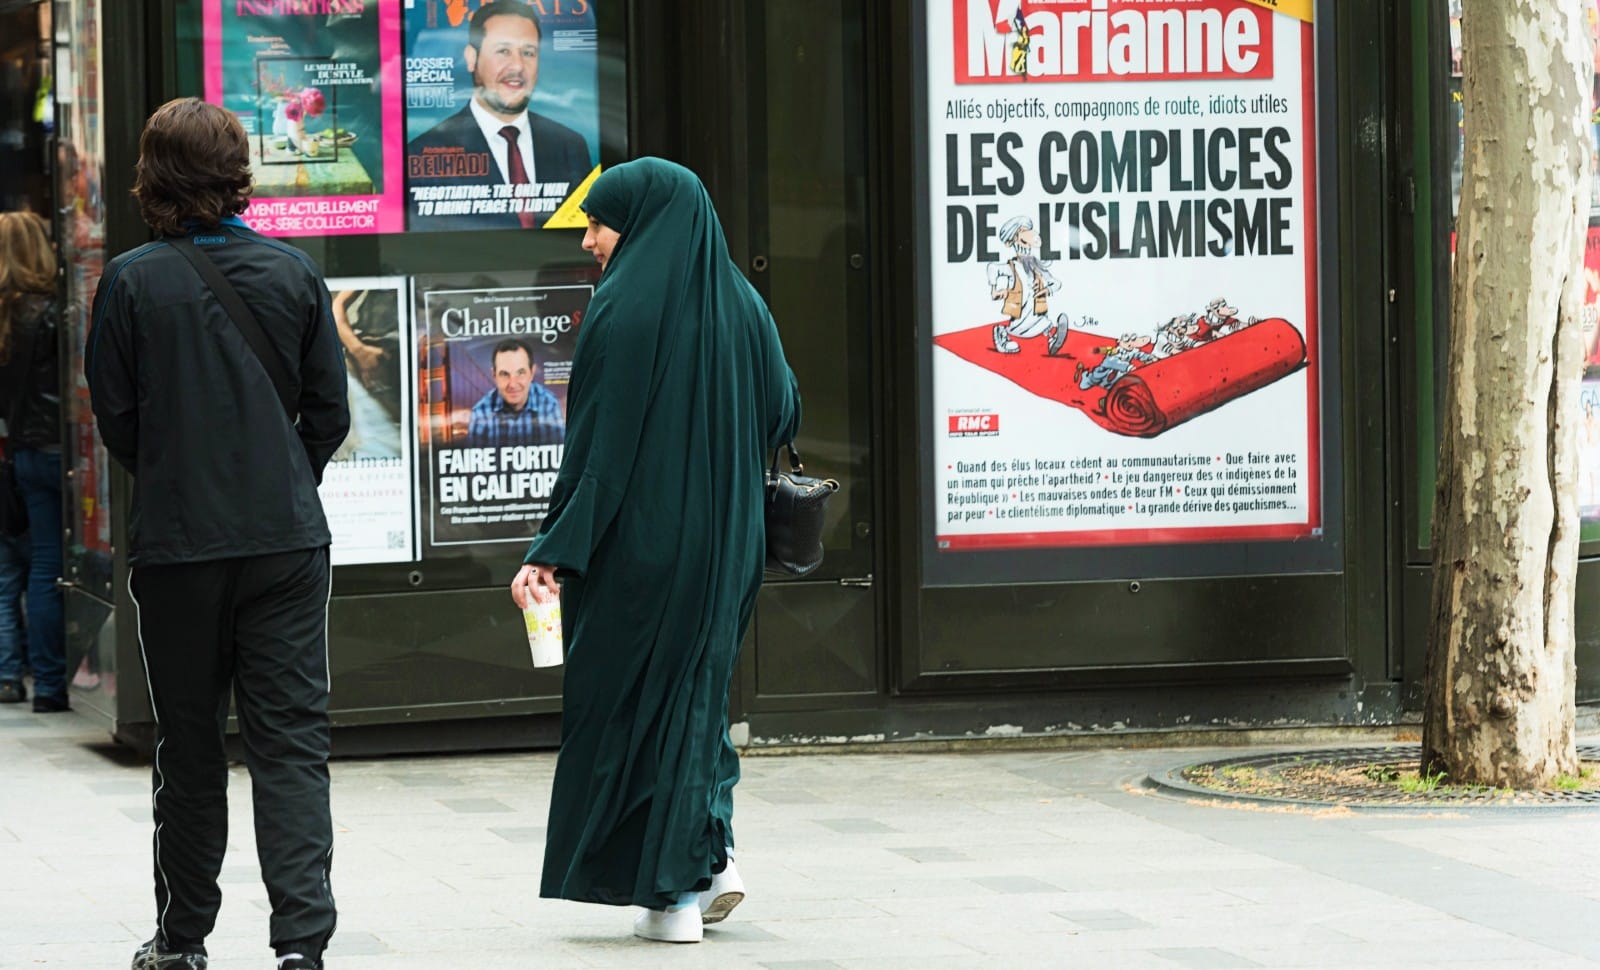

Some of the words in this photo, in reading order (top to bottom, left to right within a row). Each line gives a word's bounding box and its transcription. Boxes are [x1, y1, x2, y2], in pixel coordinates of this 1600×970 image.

[967, 0, 1260, 77] Marianne
[332, 69, 364, 79] STYLE
[406, 57, 454, 70] DOSSIER
[406, 86, 455, 108] LIBYE
[946, 100, 983, 120] Alliés
[987, 97, 1049, 123] objectifs,
[1054, 99, 1141, 124] compagnons
[1144, 96, 1160, 116] de
[1164, 96, 1204, 118] route,
[1209, 94, 1247, 115] idiots
[1251, 93, 1288, 114] utiles
[408, 152, 489, 178] BELHADJ
[946, 131, 1025, 196] LES
[1038, 127, 1293, 195] COMPLICES
[493, 184, 515, 198] THE
[514, 183, 544, 197] ONLY
[543, 182, 570, 197] WAY
[250, 202, 287, 216] VENTE
[288, 199, 380, 215] ACTUELLEMENT
[418, 201, 434, 216] TO
[434, 199, 472, 215] BRING
[472, 197, 508, 214] PEACE
[508, 198, 524, 213] TO
[303, 215, 375, 230] COLLECTOR
[946, 203, 1000, 263] DE
[1039, 197, 1294, 260] L'ISLAMISME
[441, 306, 581, 343] Challenges
[957, 415, 991, 430] RMC
[328, 451, 402, 469] Salman
[439, 447, 497, 474] FAIRE
[957, 461, 986, 473] Quand
[991, 460, 1007, 472] des
[1011, 458, 1030, 471] élus
[1035, 458, 1066, 470] locaux
[1070, 456, 1102, 469] cèdent
[1106, 458, 1118, 469] au
[1122, 453, 1211, 467] communautarisme
[1226, 452, 1244, 465] Que
[1248, 451, 1270, 464] faire
[1275, 453, 1296, 463] avec
[440, 476, 468, 502] EN
[947, 479, 959, 489] un
[962, 478, 987, 488] imam
[990, 477, 1004, 490] qui
[1008, 474, 1039, 491] prêche
[1042, 473, 1093, 487] l'apartheid
[1112, 472, 1123, 483] Le
[1125, 472, 1140, 485] jeu
[1143, 471, 1193, 484] dangereux
[1196, 469, 1213, 481] des
[1226, 467, 1271, 482] indigènes
[1275, 467, 1285, 479] de
[1288, 467, 1297, 478] la
[947, 491, 999, 506] République
[1020, 490, 1035, 502] Les
[1038, 488, 1088, 501] mauvaises
[1090, 487, 1117, 499] ondes
[1121, 486, 1132, 498] de
[1135, 486, 1156, 498] Beur
[1160, 486, 1173, 498] FM
[1185, 485, 1207, 497] Ceux
[1211, 484, 1225, 498] qui
[1228, 482, 1297, 496] démissionnent
[947, 510, 962, 523] par
[965, 509, 986, 522] peur
[996, 507, 1006, 518] Le
[1008, 505, 1064, 518] clientélisme
[1066, 503, 1125, 518] diplomatique
[1136, 502, 1146, 514] La
[1148, 501, 1180, 516] grande
[1183, 499, 1212, 513] dérive
[1214, 500, 1231, 511] des
